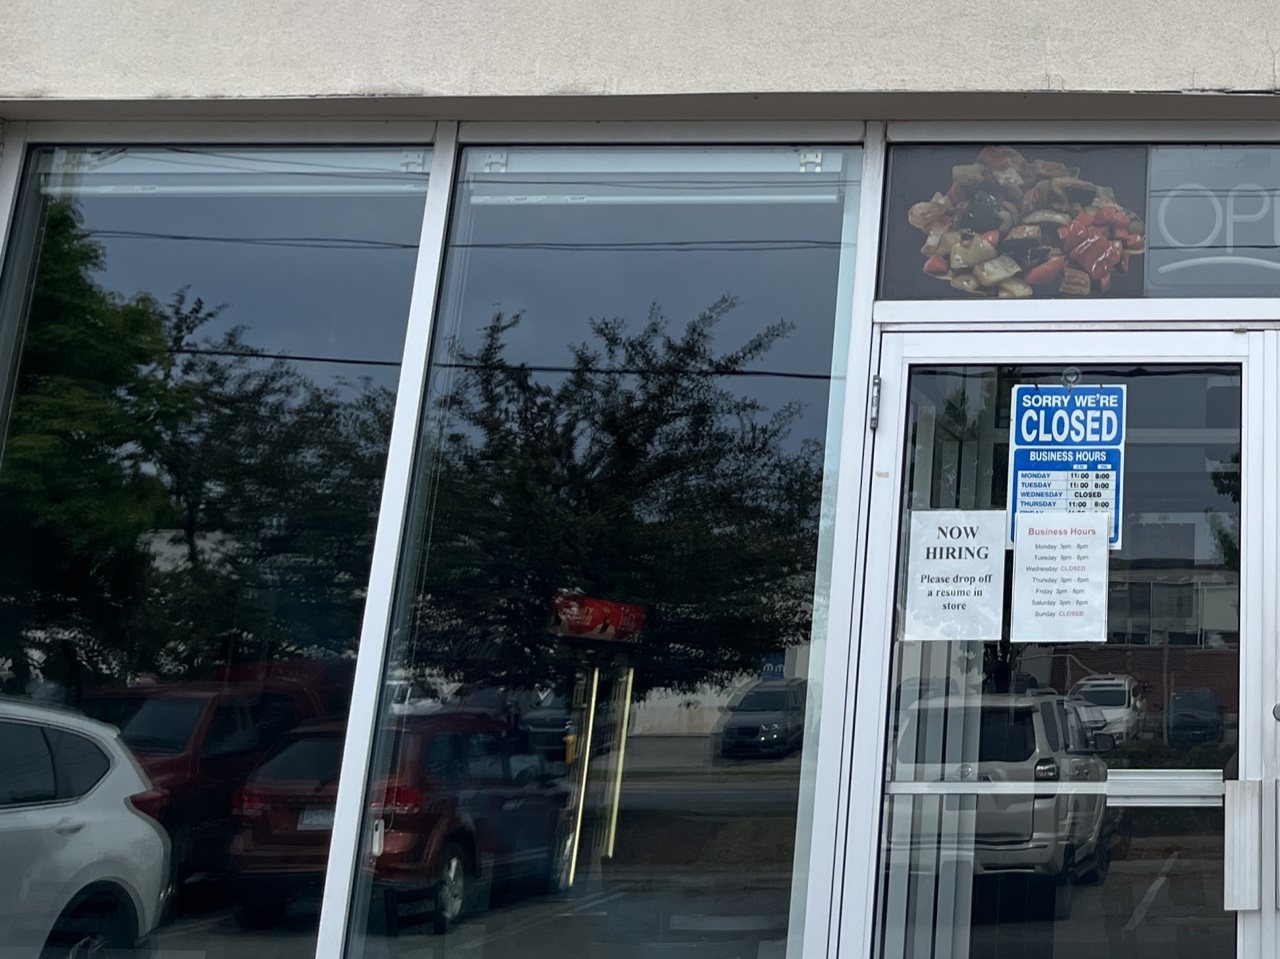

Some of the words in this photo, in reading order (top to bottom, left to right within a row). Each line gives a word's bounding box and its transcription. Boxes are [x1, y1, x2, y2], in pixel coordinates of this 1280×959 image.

[1022, 394, 1070, 407] SORRY
[1075, 393, 1118, 407] WE'RE
[1021, 409, 1118, 442] CLOSED
[1029, 451, 1073, 461] BUSINESS
[1075, 451, 1106, 461] HOURS
[936, 526, 980, 539] NOW
[1028, 527, 1068, 536] Business
[1070, 527, 1096, 536] Hours
[925, 546, 989, 560] HIRING
[920, 574, 950, 583] Please
[952, 574, 976, 585] drop
[978, 574, 993, 583] off
[974, 588, 983, 597] in
[942, 602, 967, 610] store
